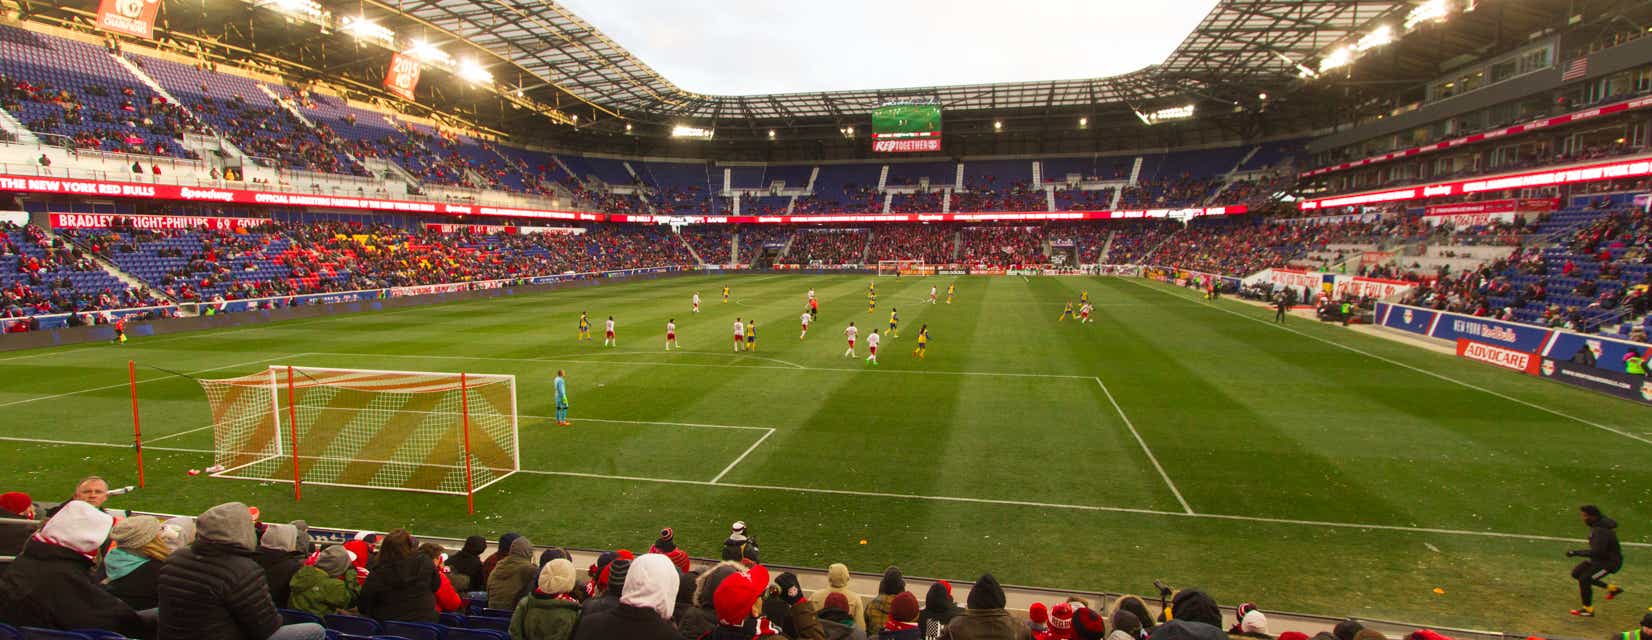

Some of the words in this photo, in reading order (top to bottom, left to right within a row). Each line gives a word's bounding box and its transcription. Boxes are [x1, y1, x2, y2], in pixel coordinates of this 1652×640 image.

[1, 179, 26, 189] THE
[29, 180, 59, 191] NEW
[62, 181, 97, 193] YORK
[99, 183, 121, 195] RED
[123, 186, 155, 197] BULLS
[181, 187, 233, 201] Speedway
[256, 193, 288, 204] OFFICIAL
[59, 214, 113, 227] BRADLEY
[217, 218, 230, 229] 69
[1453, 319, 1466, 332] NEW
[1466, 321, 1481, 336] YORK
[1468, 344, 1527, 369] ADVOCARE
